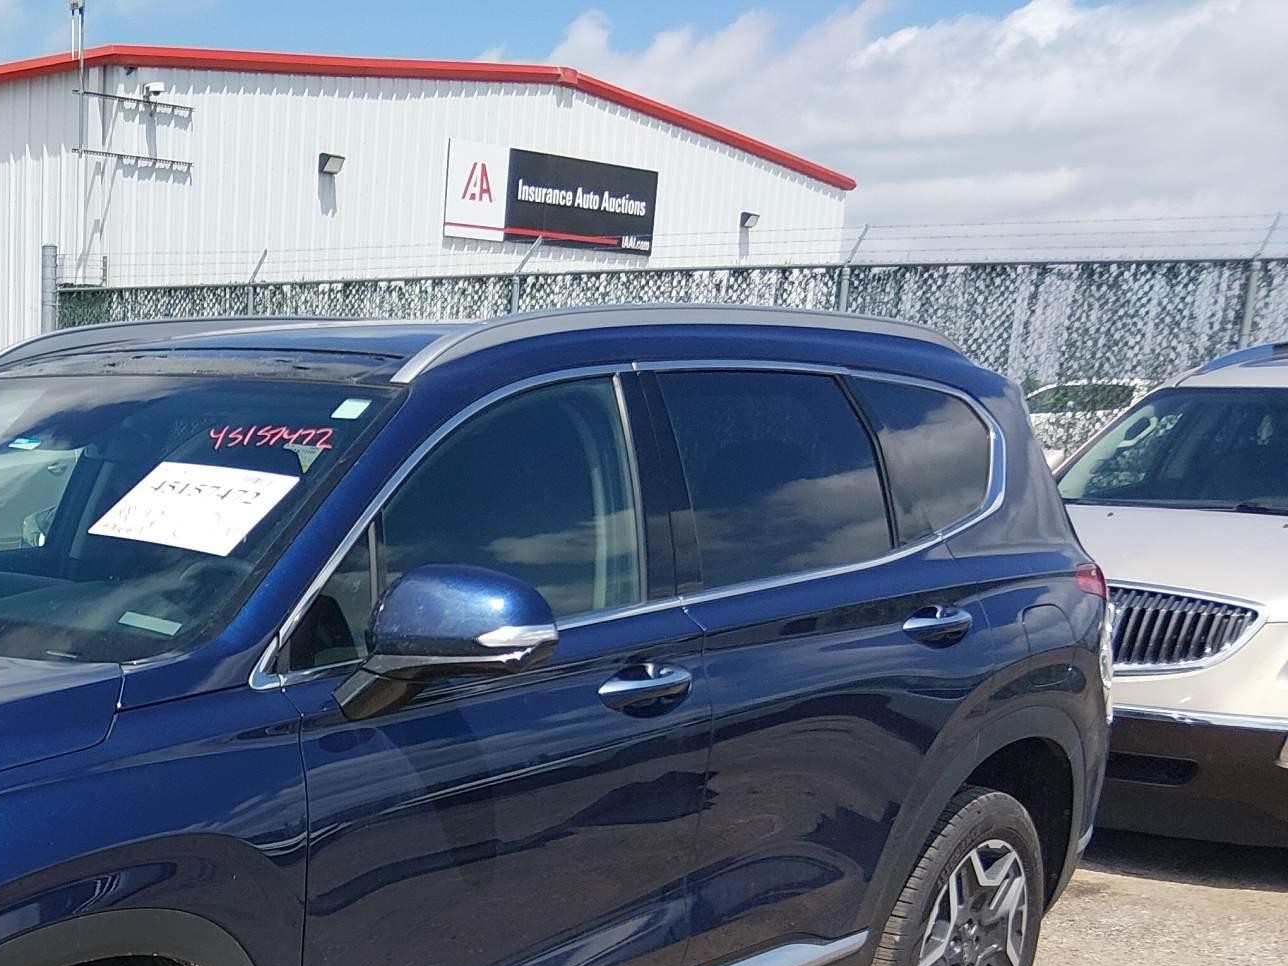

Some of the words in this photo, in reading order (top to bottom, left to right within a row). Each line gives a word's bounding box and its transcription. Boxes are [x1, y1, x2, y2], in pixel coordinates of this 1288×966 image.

[517, 179, 573, 207] Insurance
[574, 187, 599, 210] Auto
[600, 191, 646, 216] Auctions
[621, 235, 650, 251] IAAI.com
[210, 425, 333, 451] 45157472
